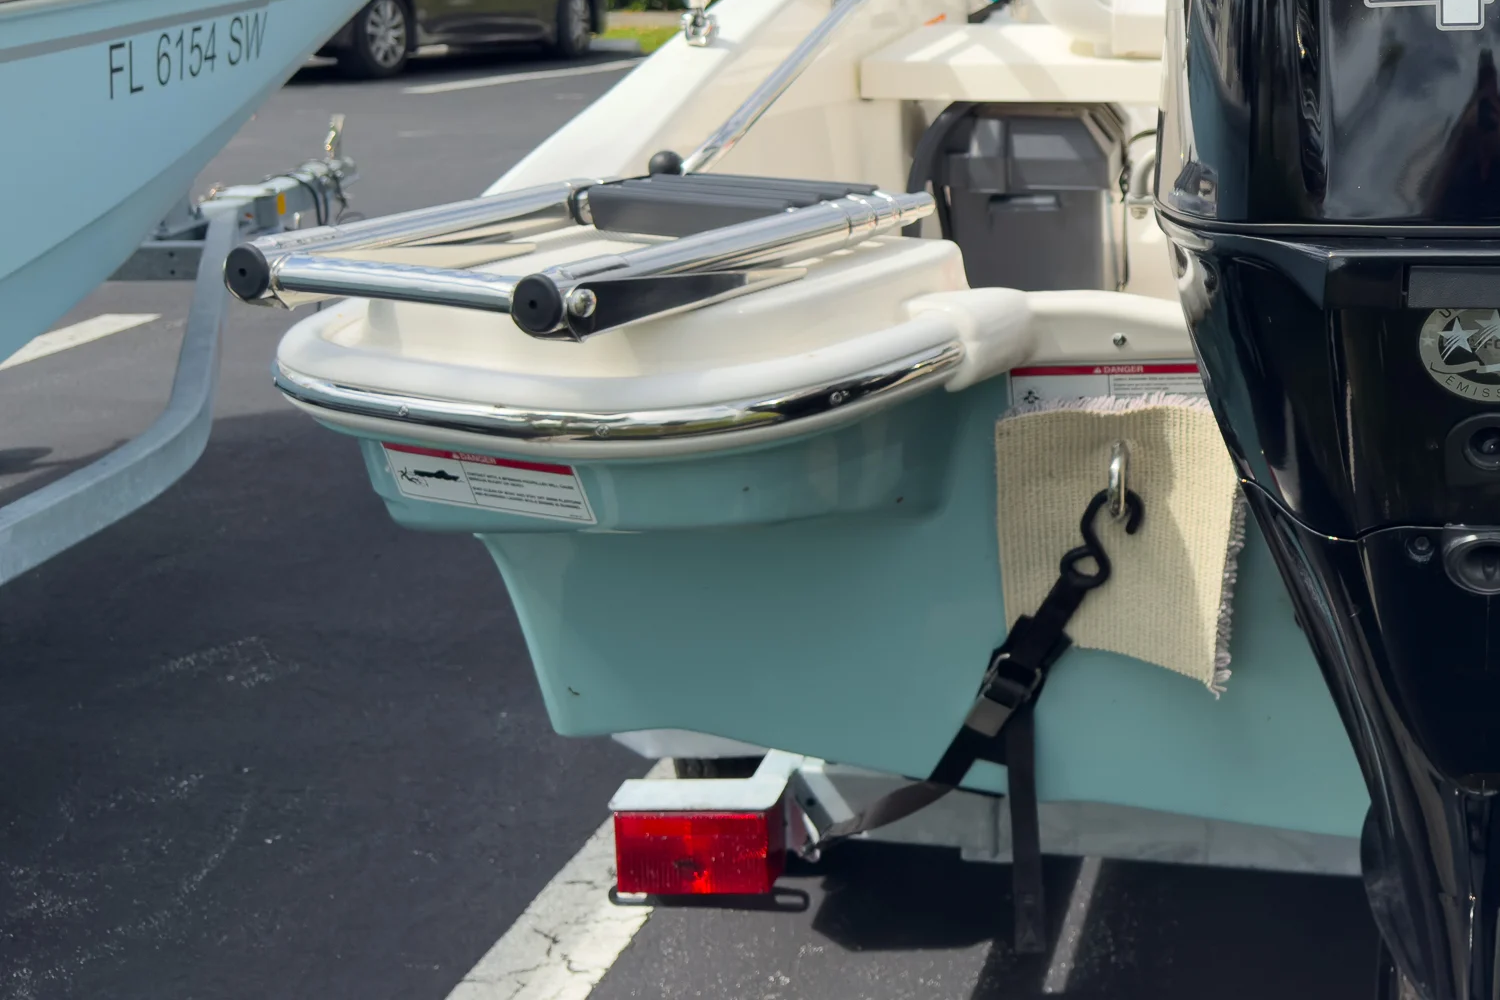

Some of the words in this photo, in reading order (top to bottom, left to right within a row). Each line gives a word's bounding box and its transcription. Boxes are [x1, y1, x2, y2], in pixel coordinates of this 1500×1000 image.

[108, 40, 144, 100] FL
[156, 22, 217, 86] 6154
[227, 11, 268, 66] SW
[1103, 365, 1144, 375] DANGER
[459, 451, 497, 466] DANGER
